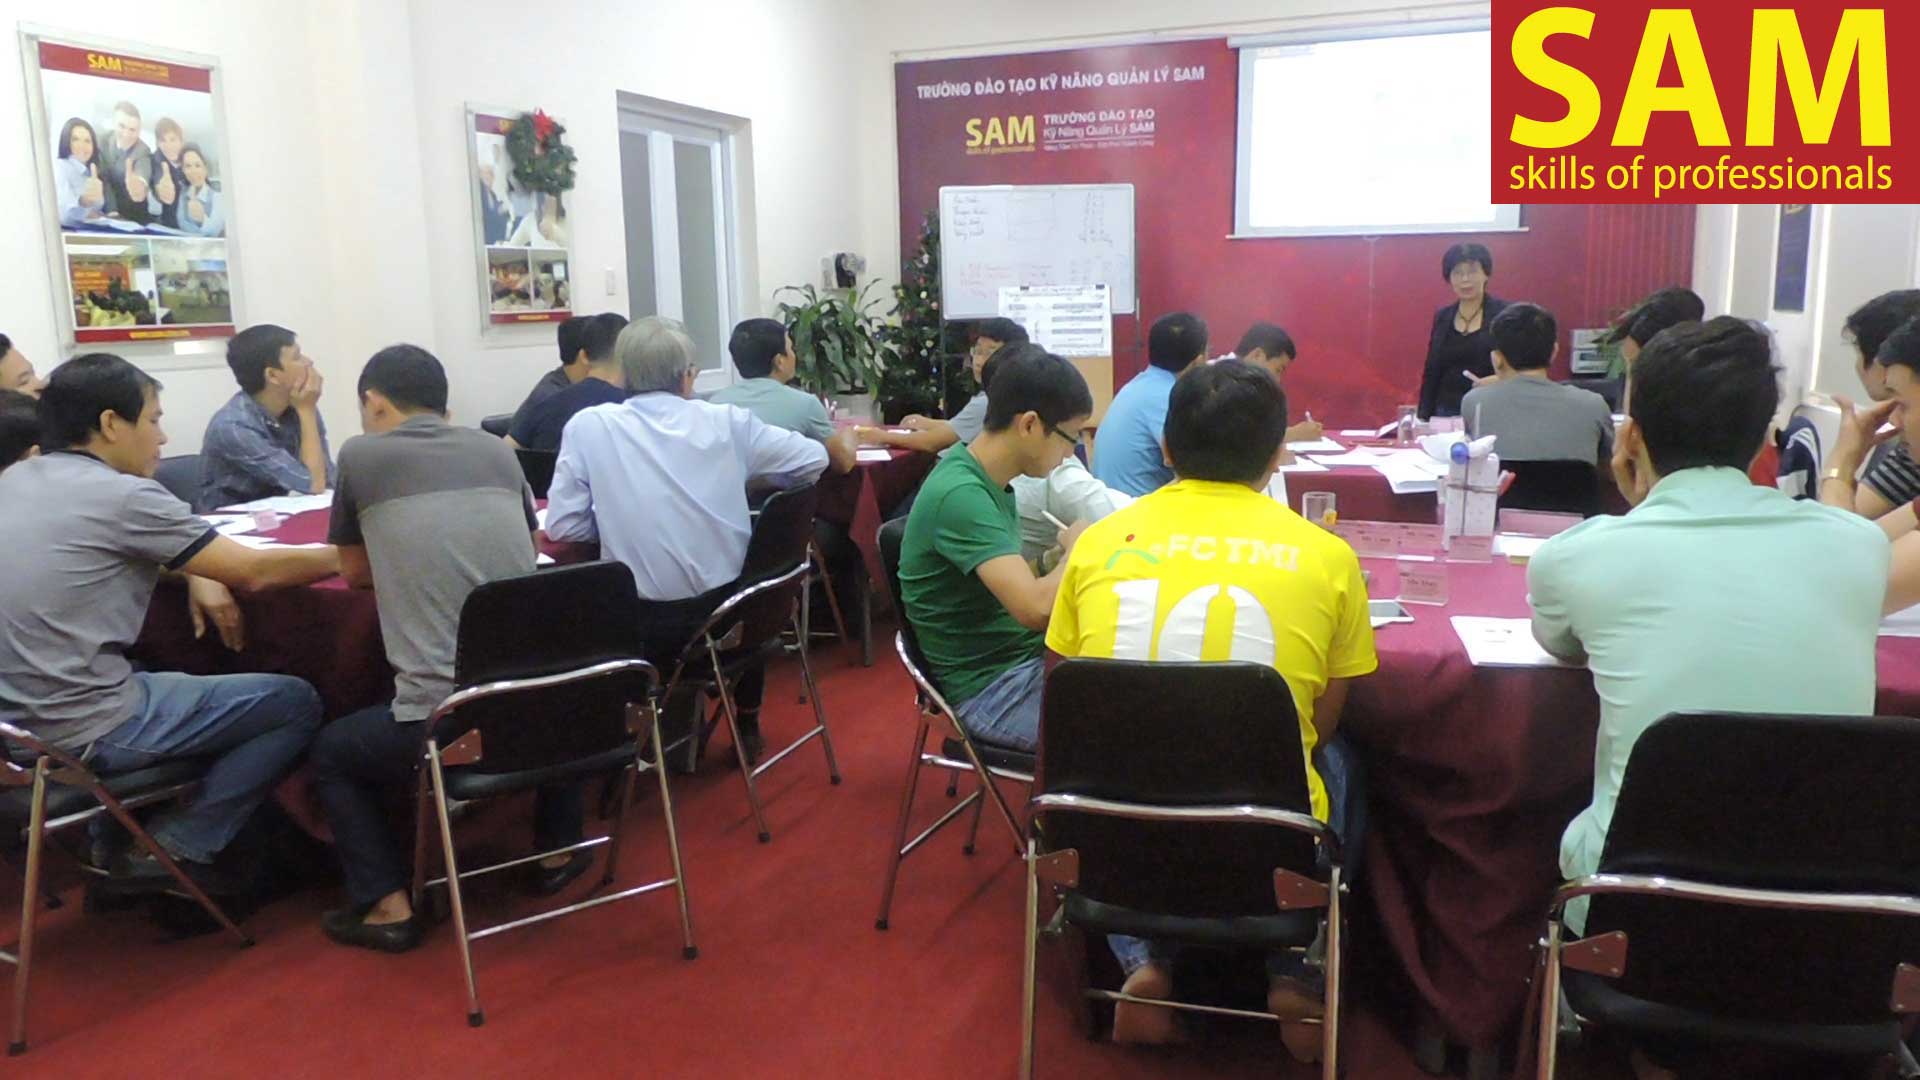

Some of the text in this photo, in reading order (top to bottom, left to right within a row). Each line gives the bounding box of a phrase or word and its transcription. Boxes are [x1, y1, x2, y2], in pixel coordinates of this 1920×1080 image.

[87, 53, 122, 72] SAM
[1008, 78, 1037, 96] TẠO
[1154, 65, 1169, 82] LÝ
[1174, 66, 1205, 82] SAM
[965, 115, 1036, 147] SAM
[1129, 121, 1155, 134] SAM
[1112, 578, 1276, 663] 10
